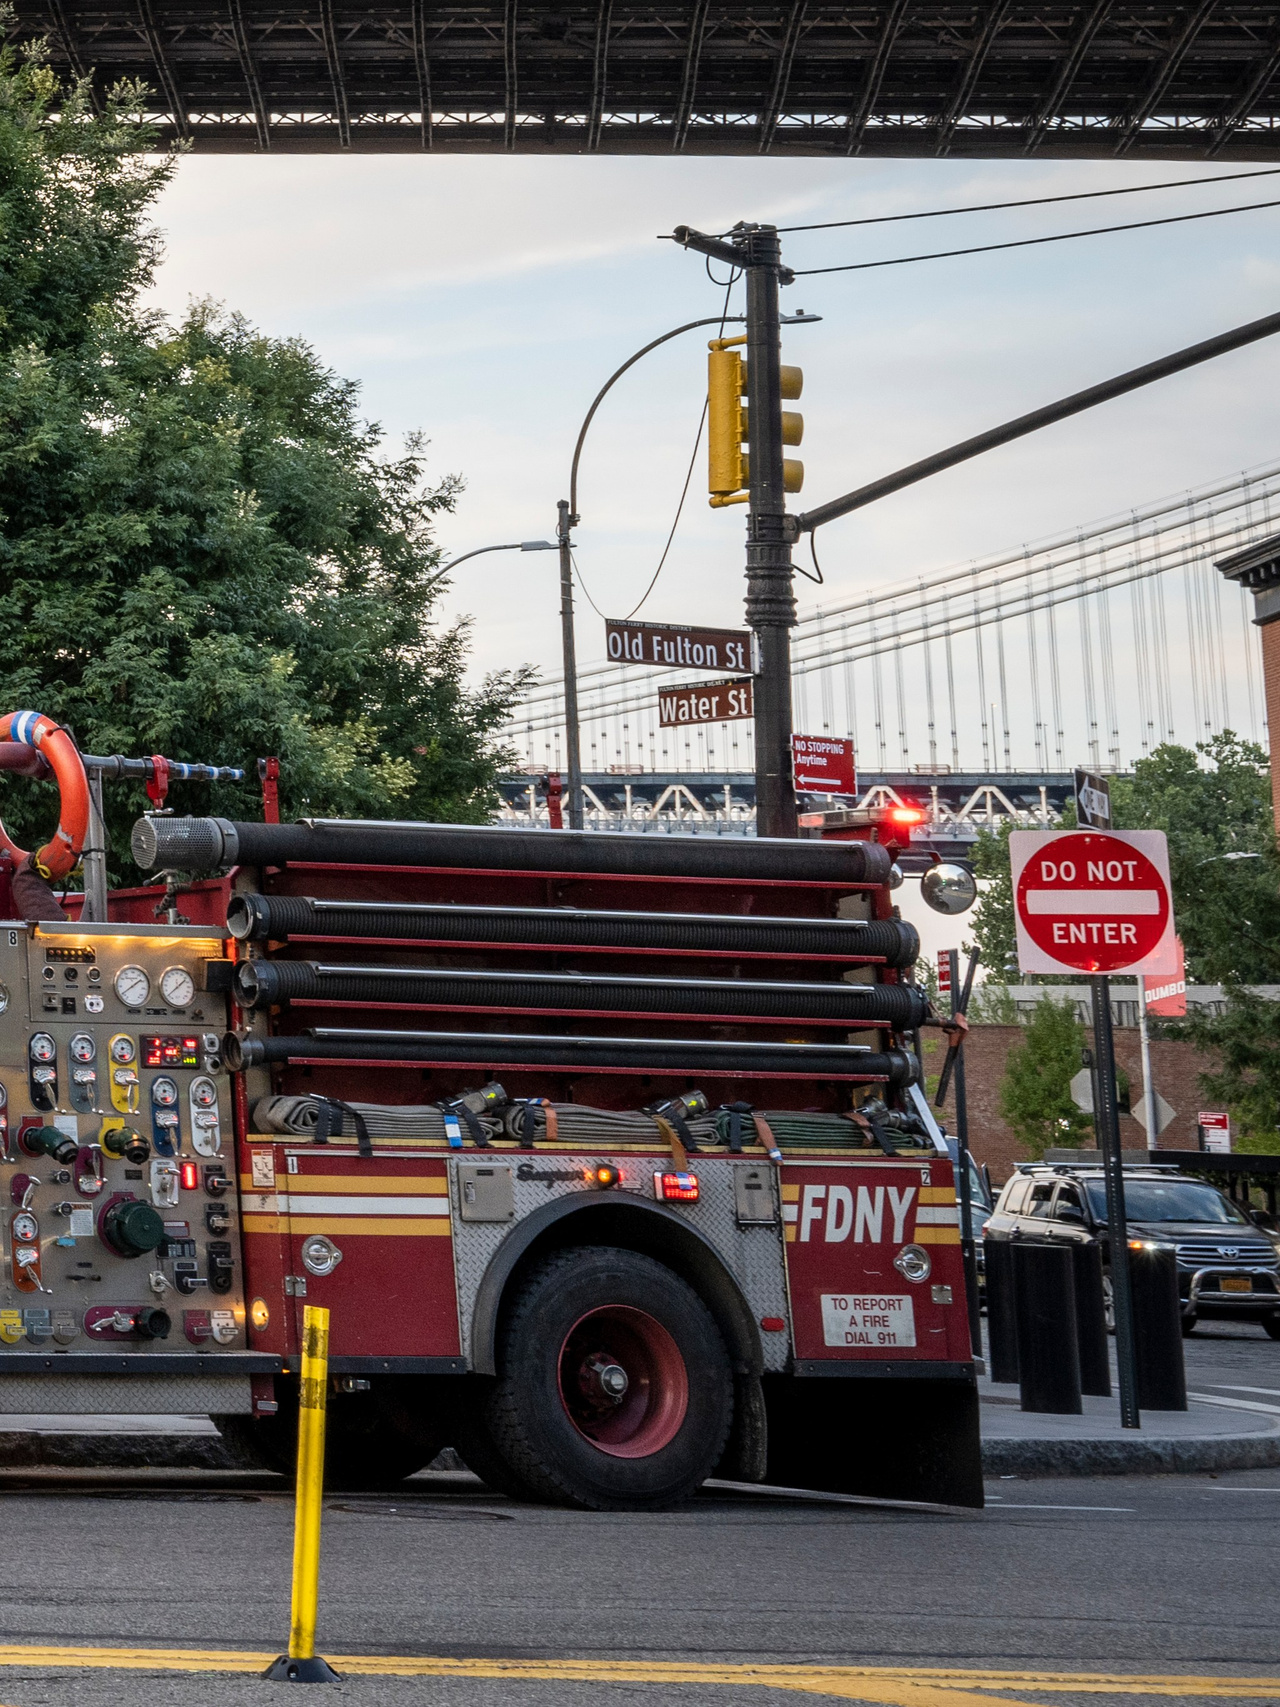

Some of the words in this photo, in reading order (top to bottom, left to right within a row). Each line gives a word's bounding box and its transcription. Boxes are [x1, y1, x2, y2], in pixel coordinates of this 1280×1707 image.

[608, 631, 644, 660] Old
[652, 635, 718, 667] Fulton
[725, 642, 745, 669] St
[660, 693, 720, 722] Water
[727, 688, 748, 716] St
[795, 740, 806, 751] NO
[807, 741, 844, 755] STOPPING
[796, 753, 827, 767] Anytime
[1040, 861, 1077, 882] DO
[1087, 860, 1138, 882] NOT
[9, 931, 17, 946] 8
[1052, 922, 1138, 944] ENTER
[1145, 981, 1186, 1004] DUMBO
[922, 1171, 930, 1185] 2
[799, 1184, 917, 1244] FDNY
[831, 1298, 848, 1311] TO
[853, 1298, 903, 1311] REPORT
[849, 1315, 858, 1327] A
[862, 1315, 890, 1328] FIRE
[845, 1332, 873, 1344] DIAL
[877, 1332, 897, 1345] 911
